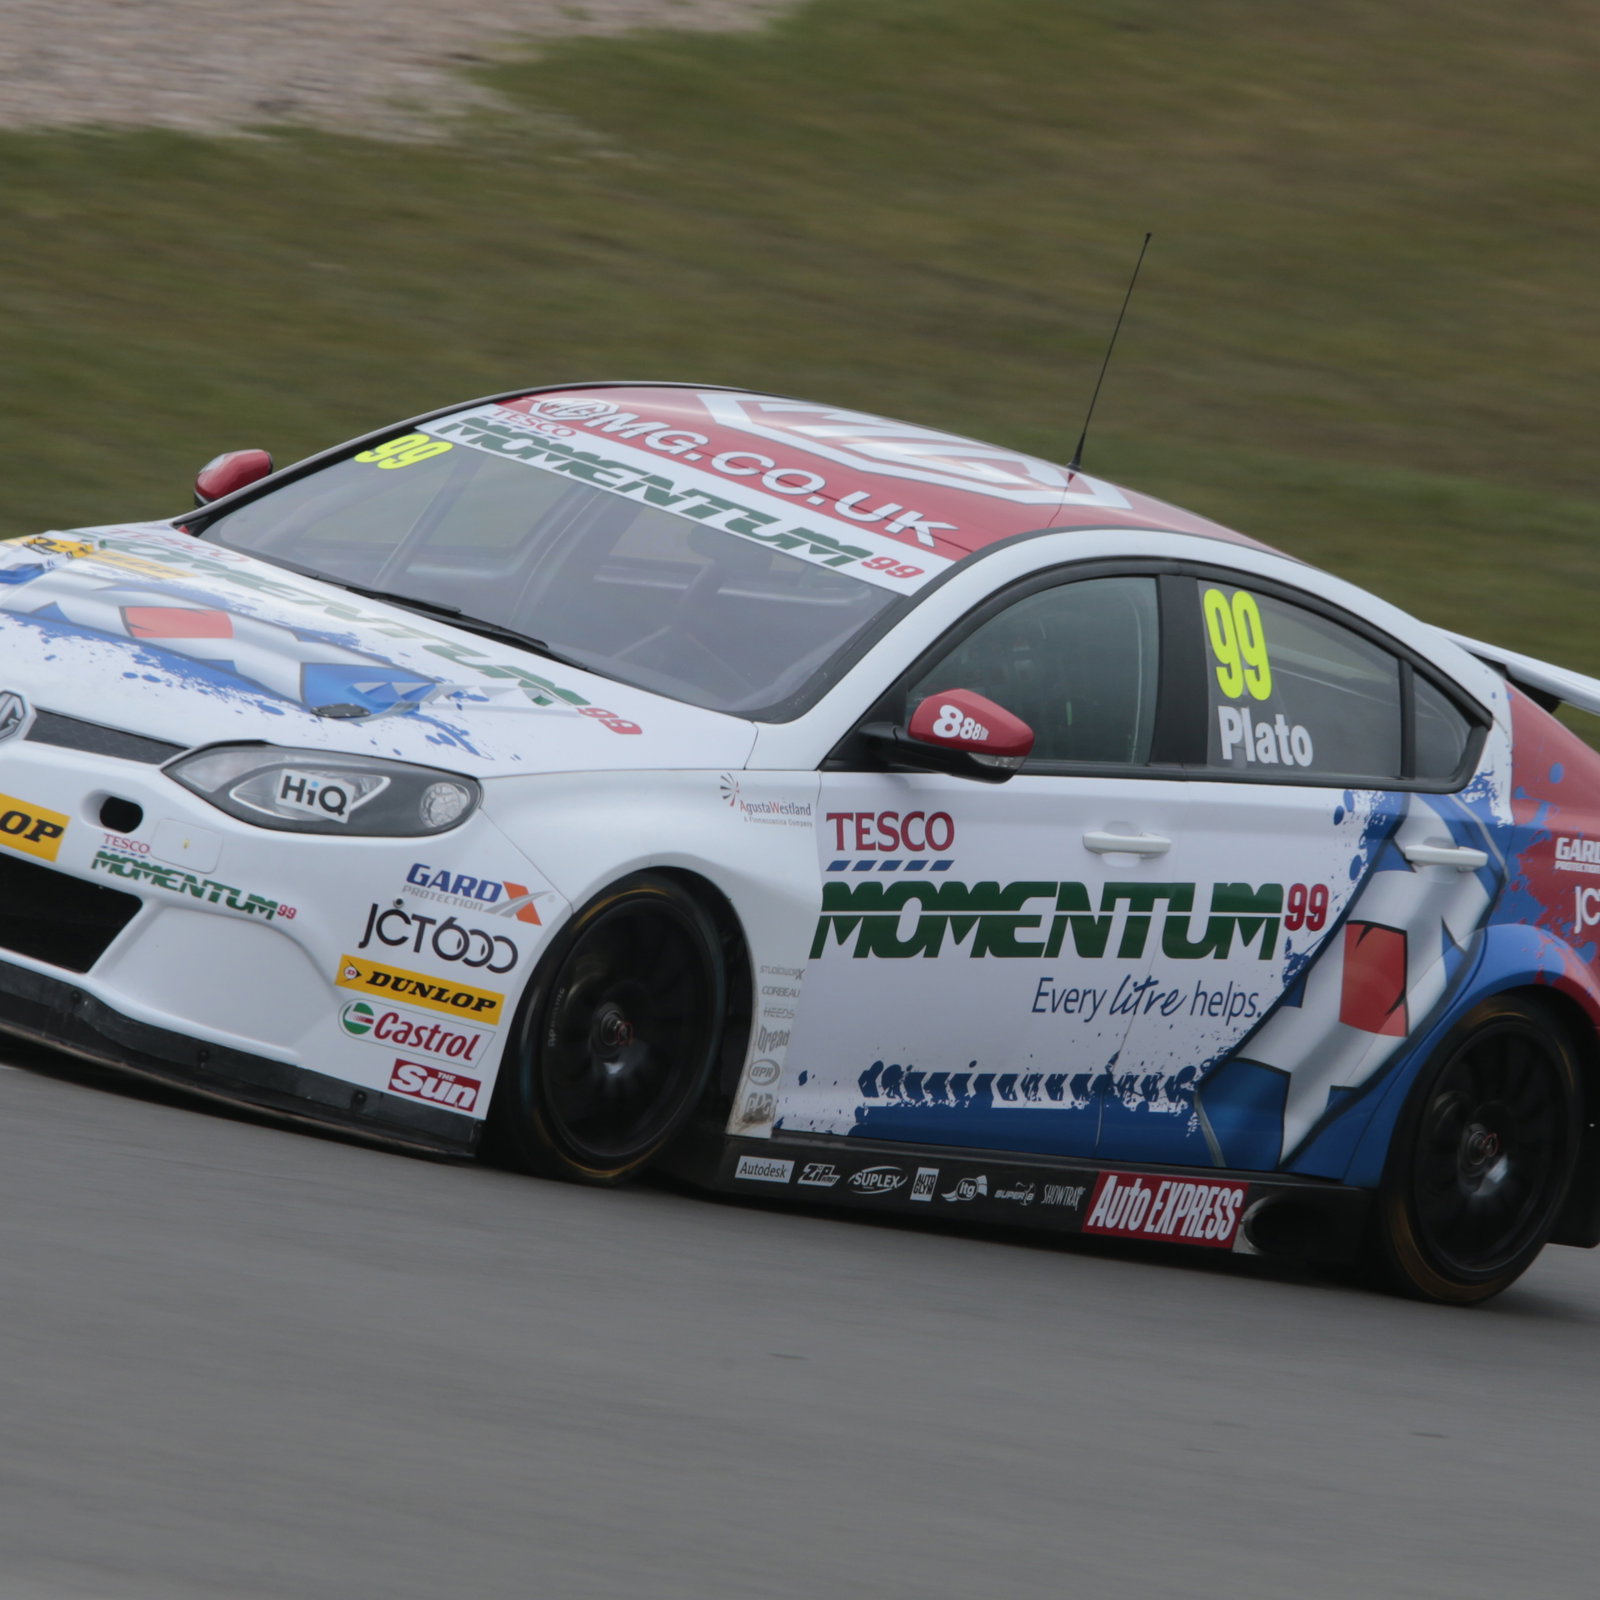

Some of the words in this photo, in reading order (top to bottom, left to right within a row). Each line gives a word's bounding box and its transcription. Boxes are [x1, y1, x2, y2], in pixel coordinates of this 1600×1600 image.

[493, 408, 577, 438] TESCO
[354, 433, 454, 470] 99
[434, 416, 875, 568] MOMENTUM
[861, 556, 925, 579] 99
[584, 412, 960, 548] MG.CO.UK
[1203, 588, 1272, 700] 99
[576, 706, 643, 736] 99
[1217, 705, 1314, 767] Plato
[280, 774, 348, 817] HiQ
[739, 800, 812, 816] AgustaWestland
[103, 833, 150, 854] TESCO
[826, 811, 955, 852] TESCO
[90, 850, 280, 921] MOMENTUM
[277, 904, 297, 920] 99
[401, 883, 484, 914] PROTECTION
[358, 898, 519, 975] JCT600
[808, 881, 1284, 960] MOMENTUM
[1284, 883, 1330, 931] 99
[366, 970, 497, 1013] DUNLOP
[762, 985, 801, 998] CORBEAU
[1032, 977, 1108, 1022] Every
[1108, 974, 1188, 1018] litre
[1189, 980, 1262, 1026] helps.
[373, 1011, 481, 1061] Castrol
[391, 1064, 477, 1109] Sun
[437, 1072, 457, 1083] THE
[739, 1161, 787, 1179] Autodesk
[853, 1170, 900, 1190] SUPLEX
[1088, 1175, 1144, 1230] Auto
[1143, 1179, 1244, 1241] EXPRESS
